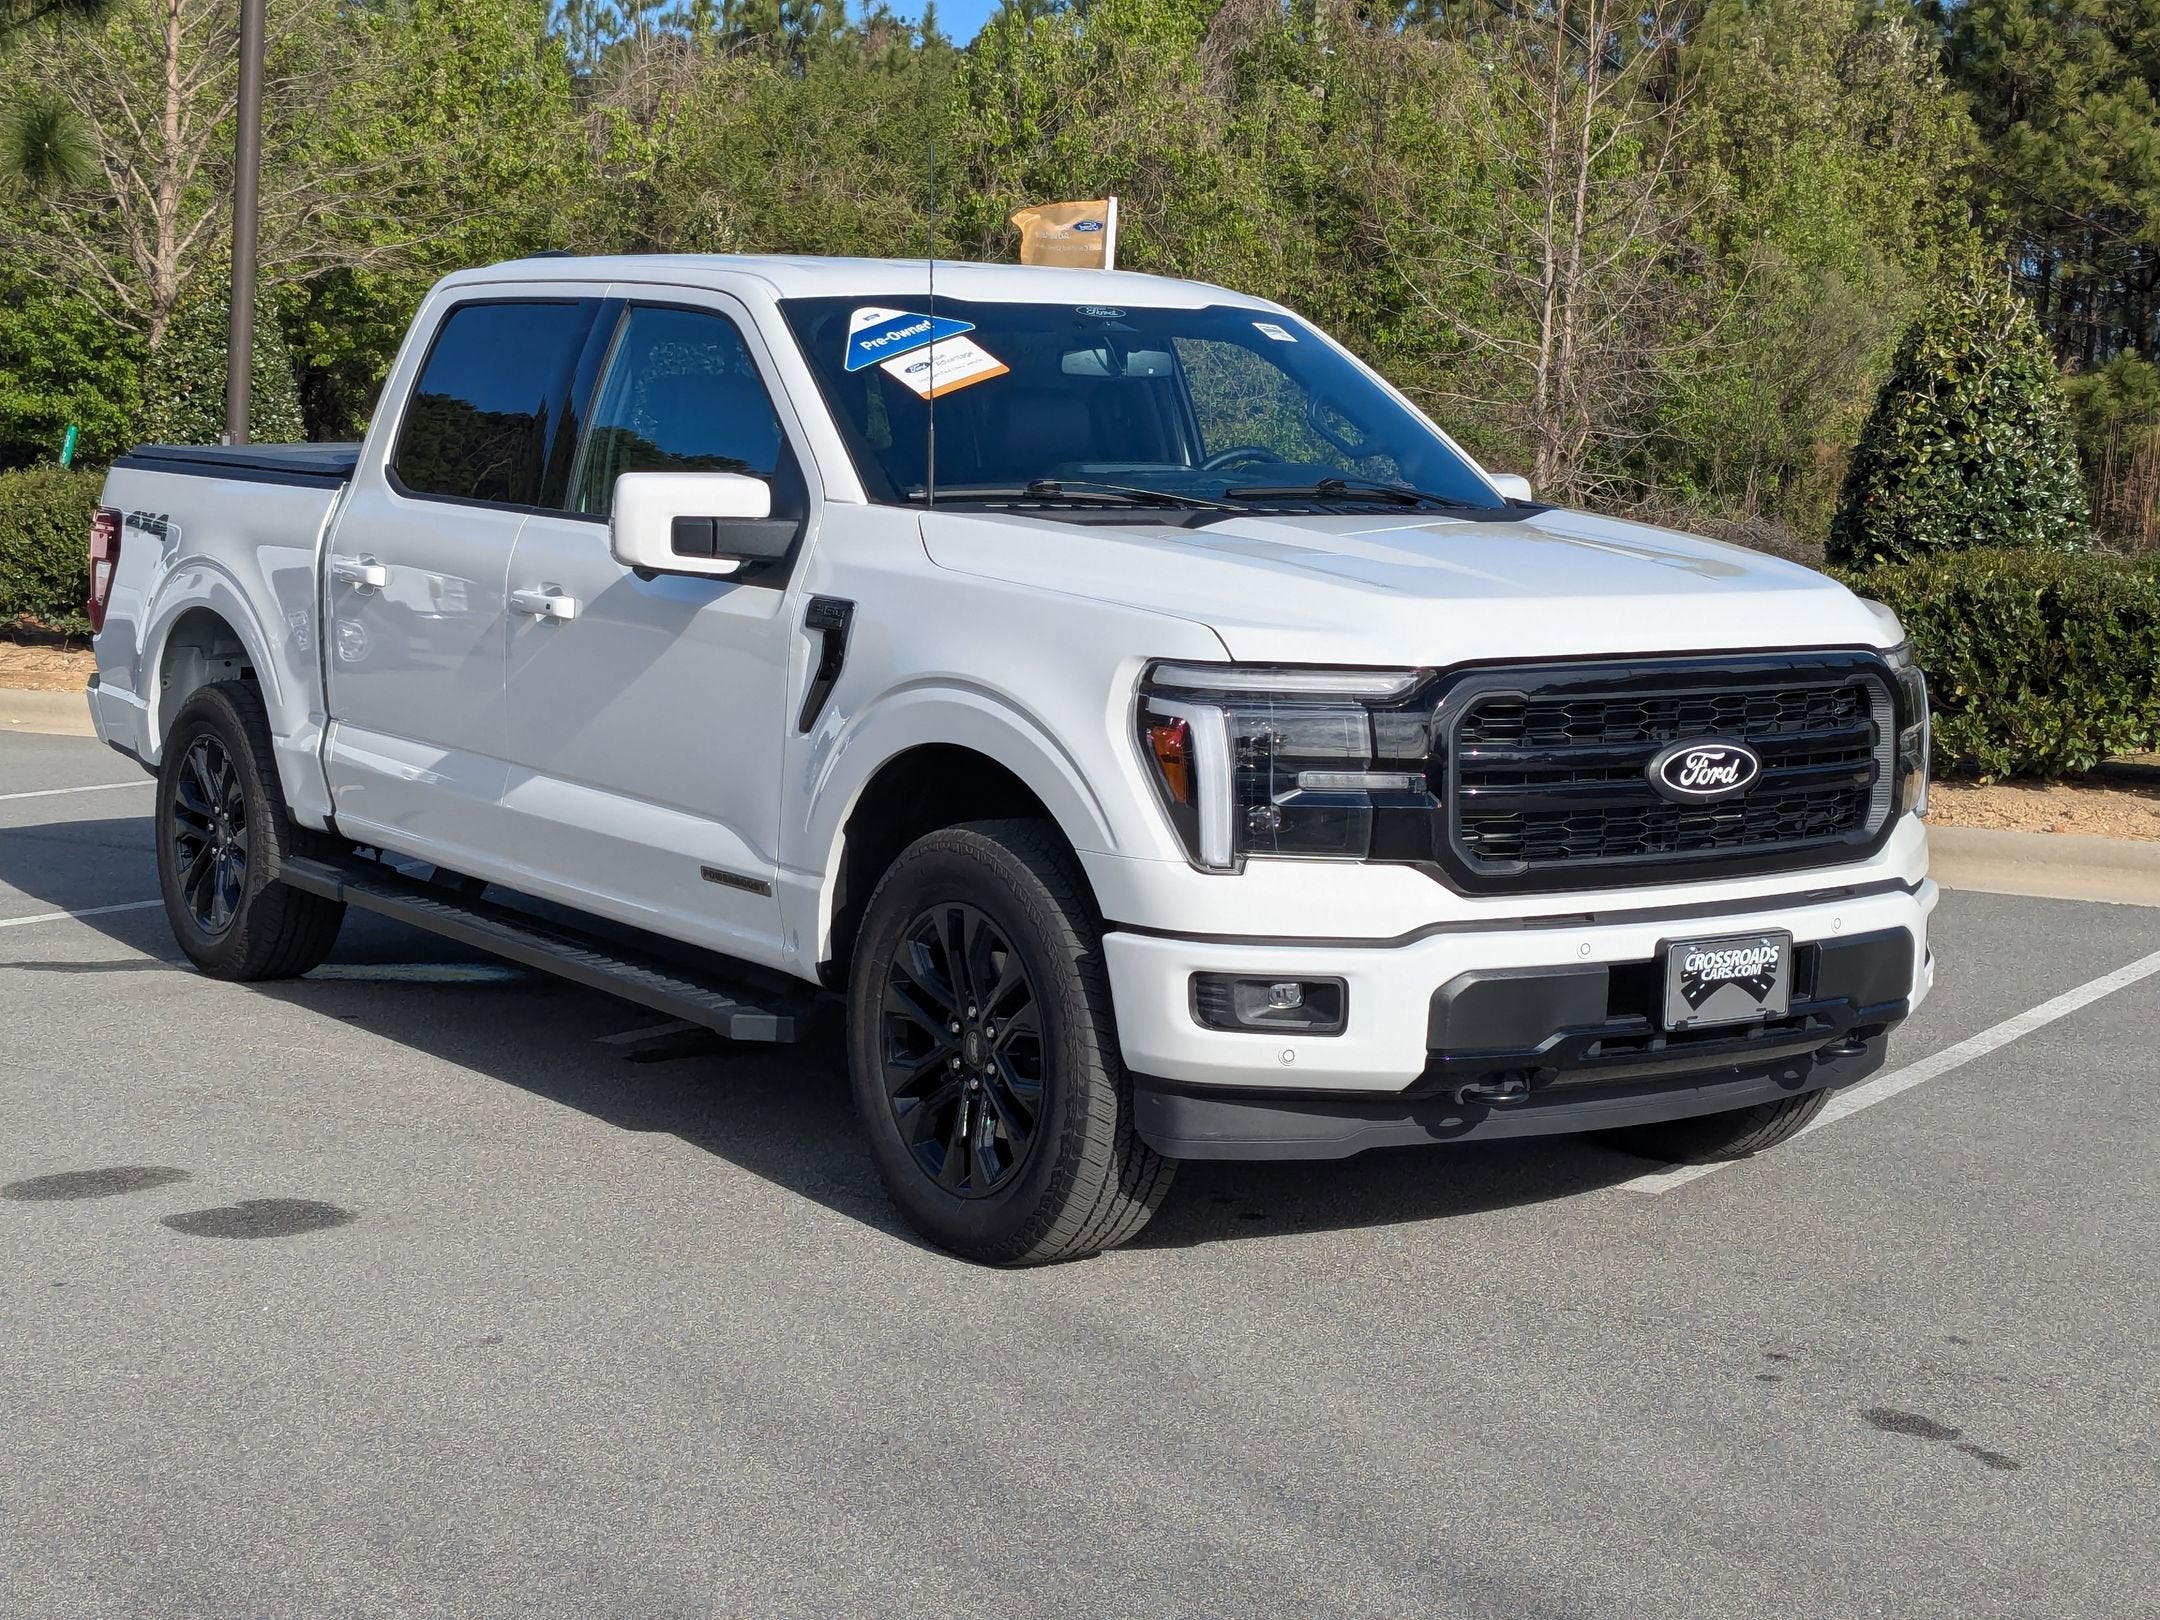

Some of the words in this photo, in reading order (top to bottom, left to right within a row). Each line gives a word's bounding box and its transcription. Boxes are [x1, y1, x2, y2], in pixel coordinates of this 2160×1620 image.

[1680, 752, 1740, 786] Ford
[1684, 945, 1779, 971] CROSSROADS
[1701, 963, 1762, 981] CARS.COM
